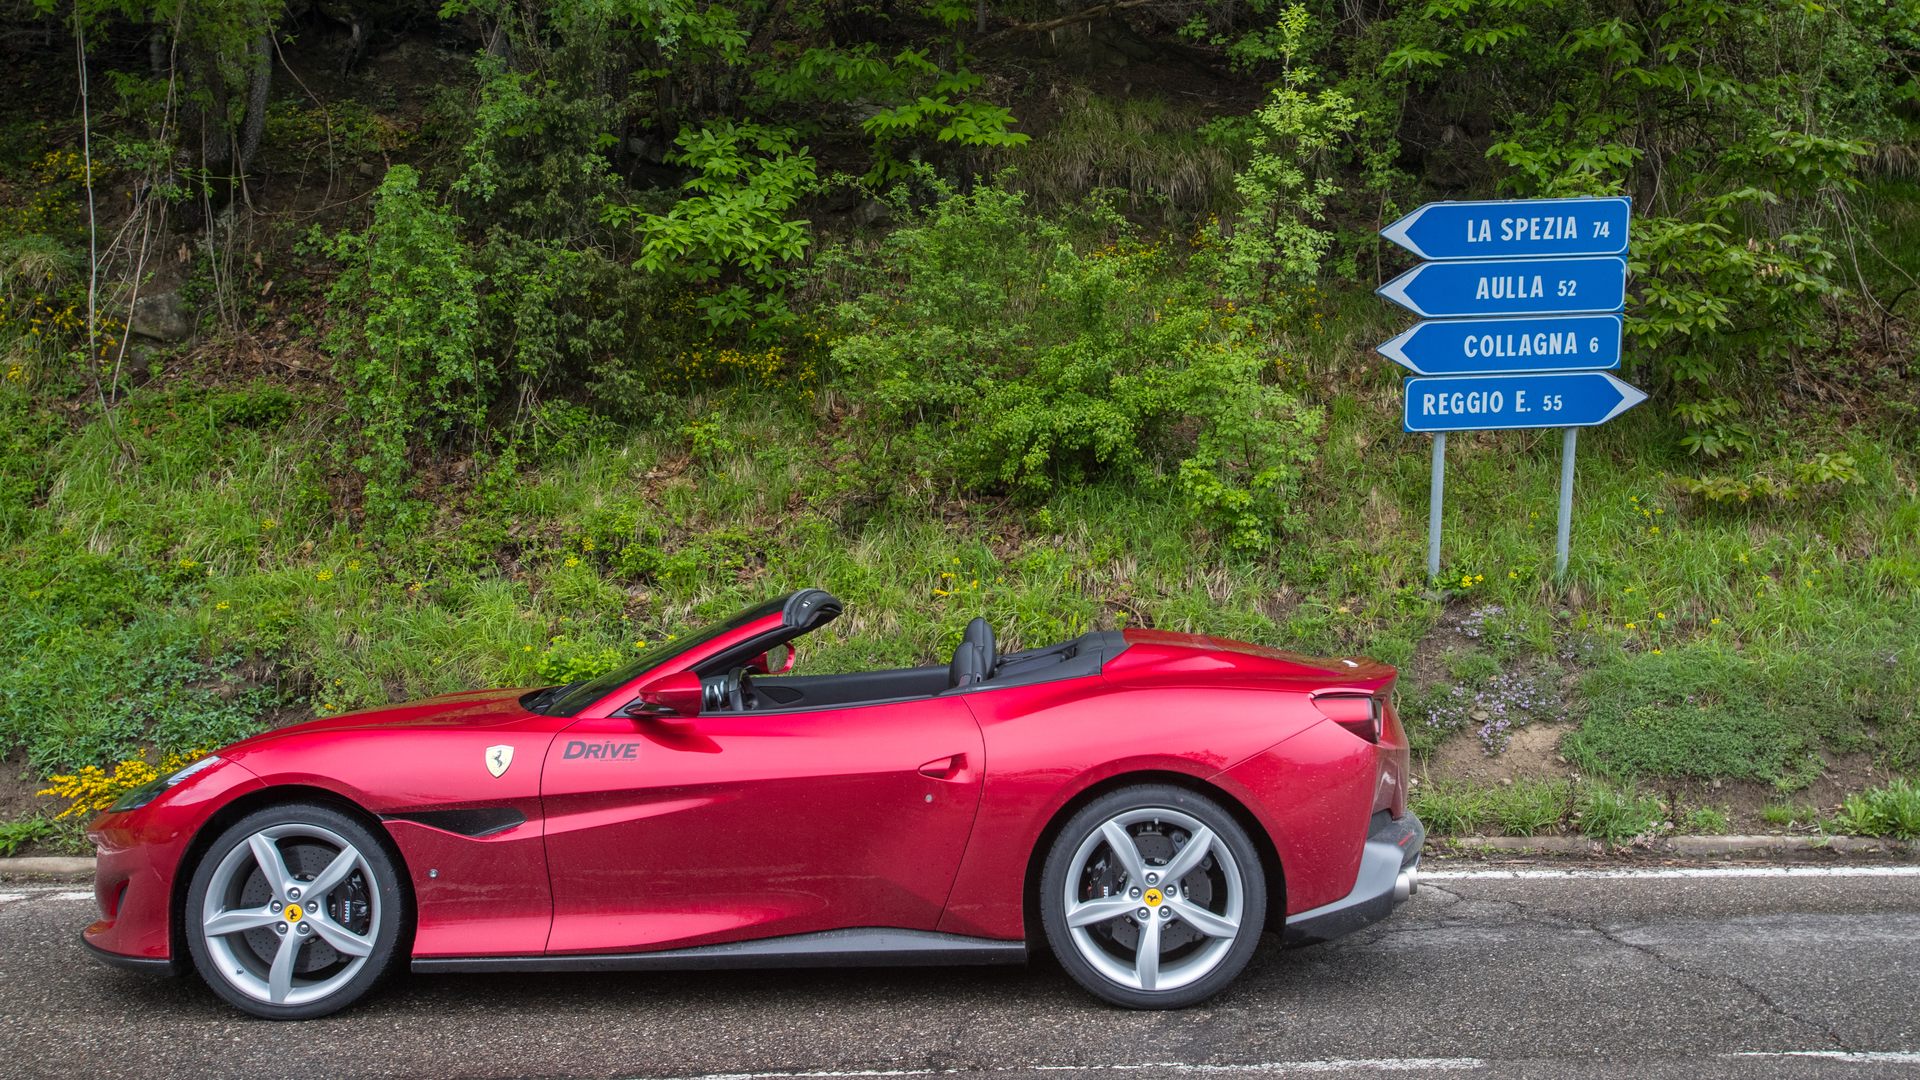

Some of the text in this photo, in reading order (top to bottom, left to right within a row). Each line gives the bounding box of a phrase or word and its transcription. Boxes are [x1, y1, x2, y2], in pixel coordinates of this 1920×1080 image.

[1467, 216, 1610, 243] LA SPEZIA 74
[1475, 275, 1577, 300] AULLA 52
[1463, 332, 1599, 358] COLLAGNA 6
[1423, 390, 1563, 416] REGGIO E. 55
